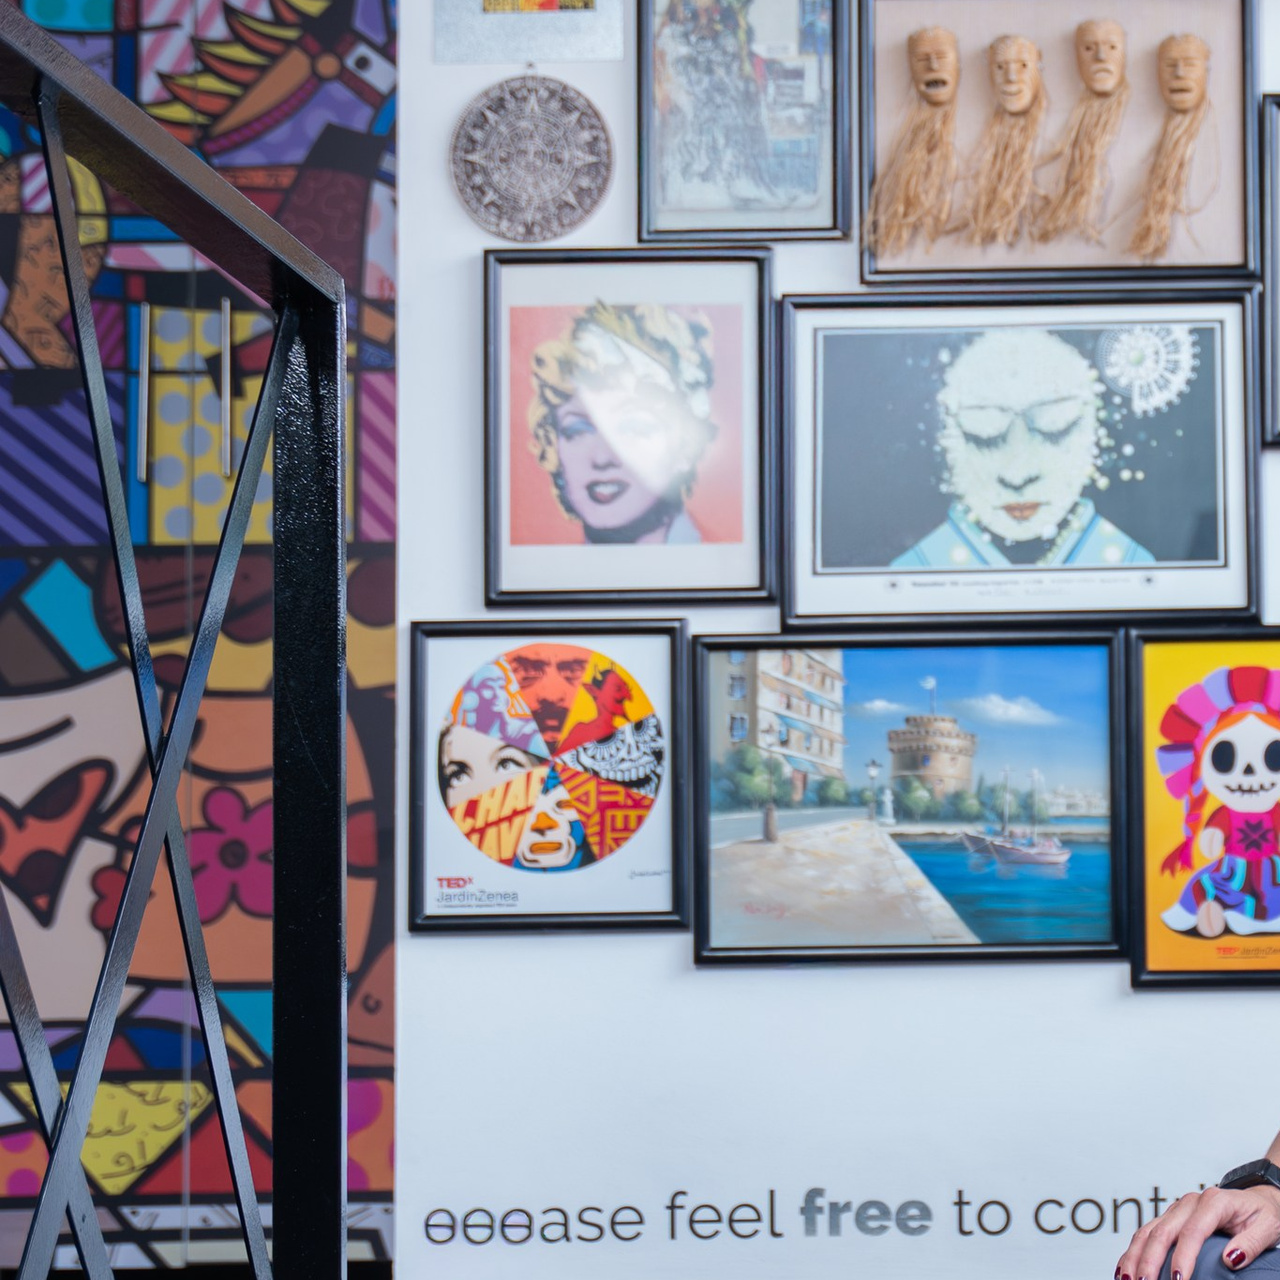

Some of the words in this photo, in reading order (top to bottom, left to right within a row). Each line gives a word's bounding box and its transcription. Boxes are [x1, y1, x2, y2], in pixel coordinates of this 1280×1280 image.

[666, 1189, 783, 1240] feel
[799, 1187, 933, 1237] free
[953, 1188, 1012, 1236] to
